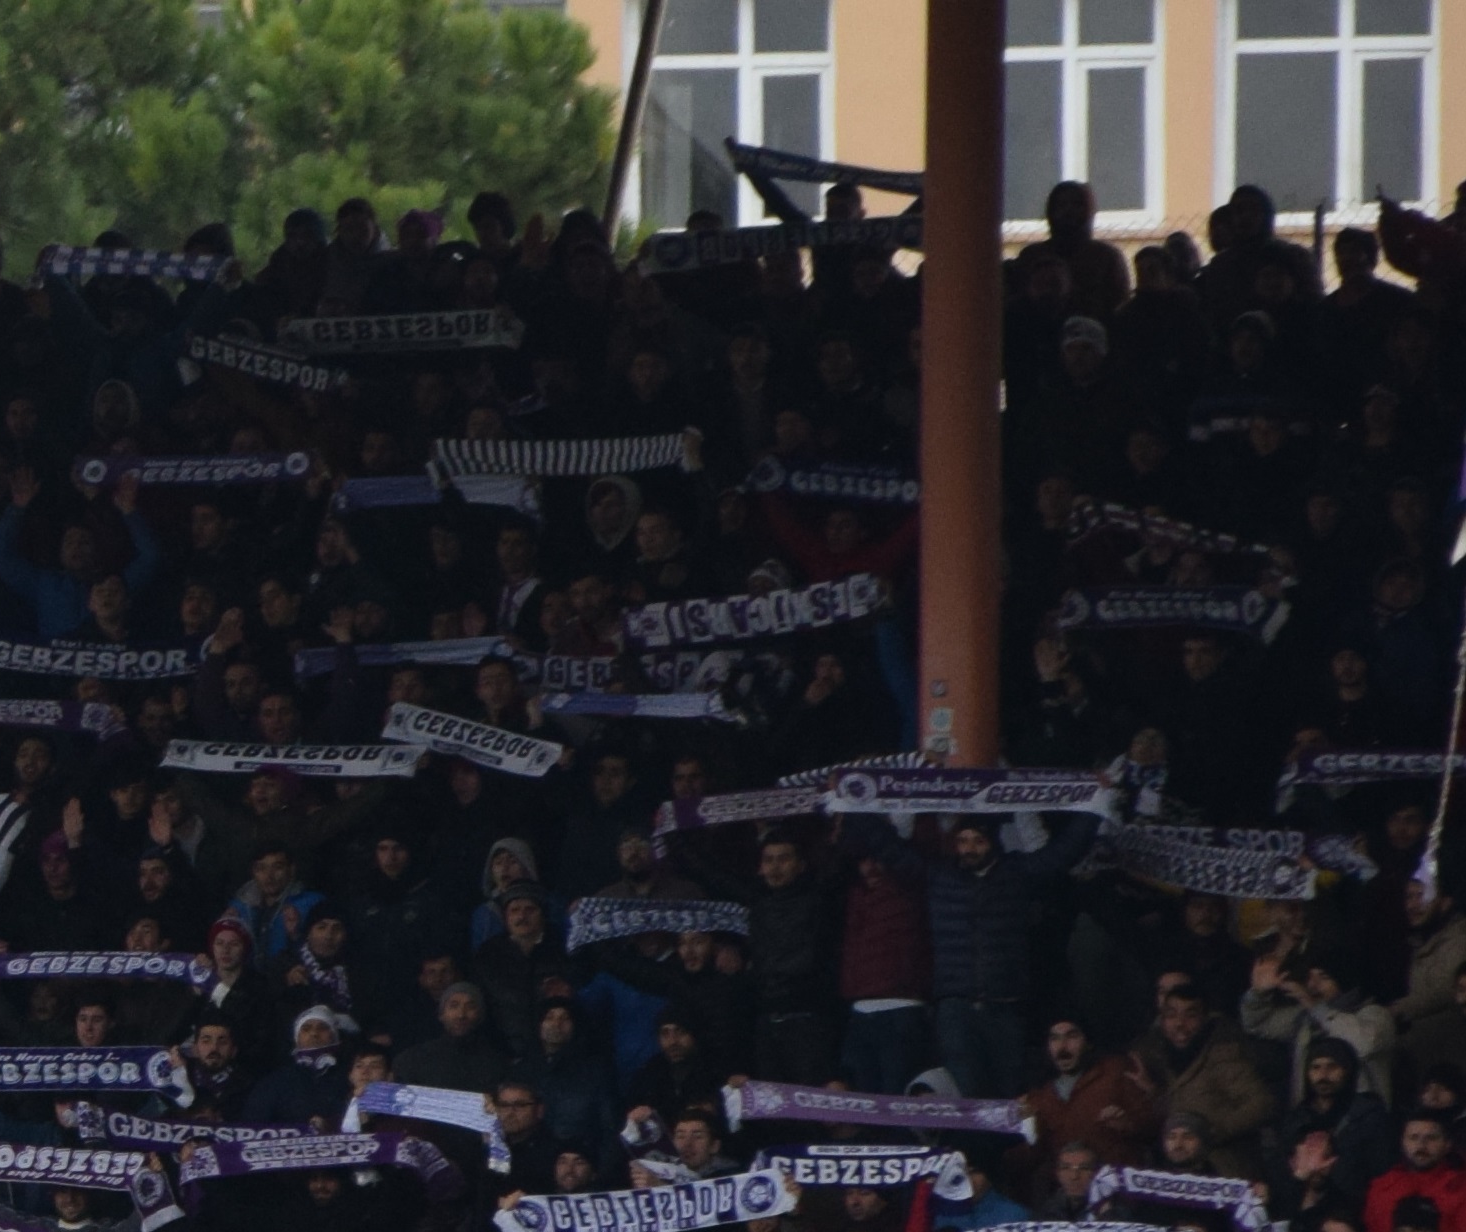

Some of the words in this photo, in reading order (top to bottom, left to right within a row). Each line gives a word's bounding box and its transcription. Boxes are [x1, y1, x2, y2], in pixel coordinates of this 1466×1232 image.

[790, 472, 919, 503] GEBZESPO
[6, 956, 185, 977] GEBZESPOR
[241, 1141, 379, 1164] GEBZESPOR
